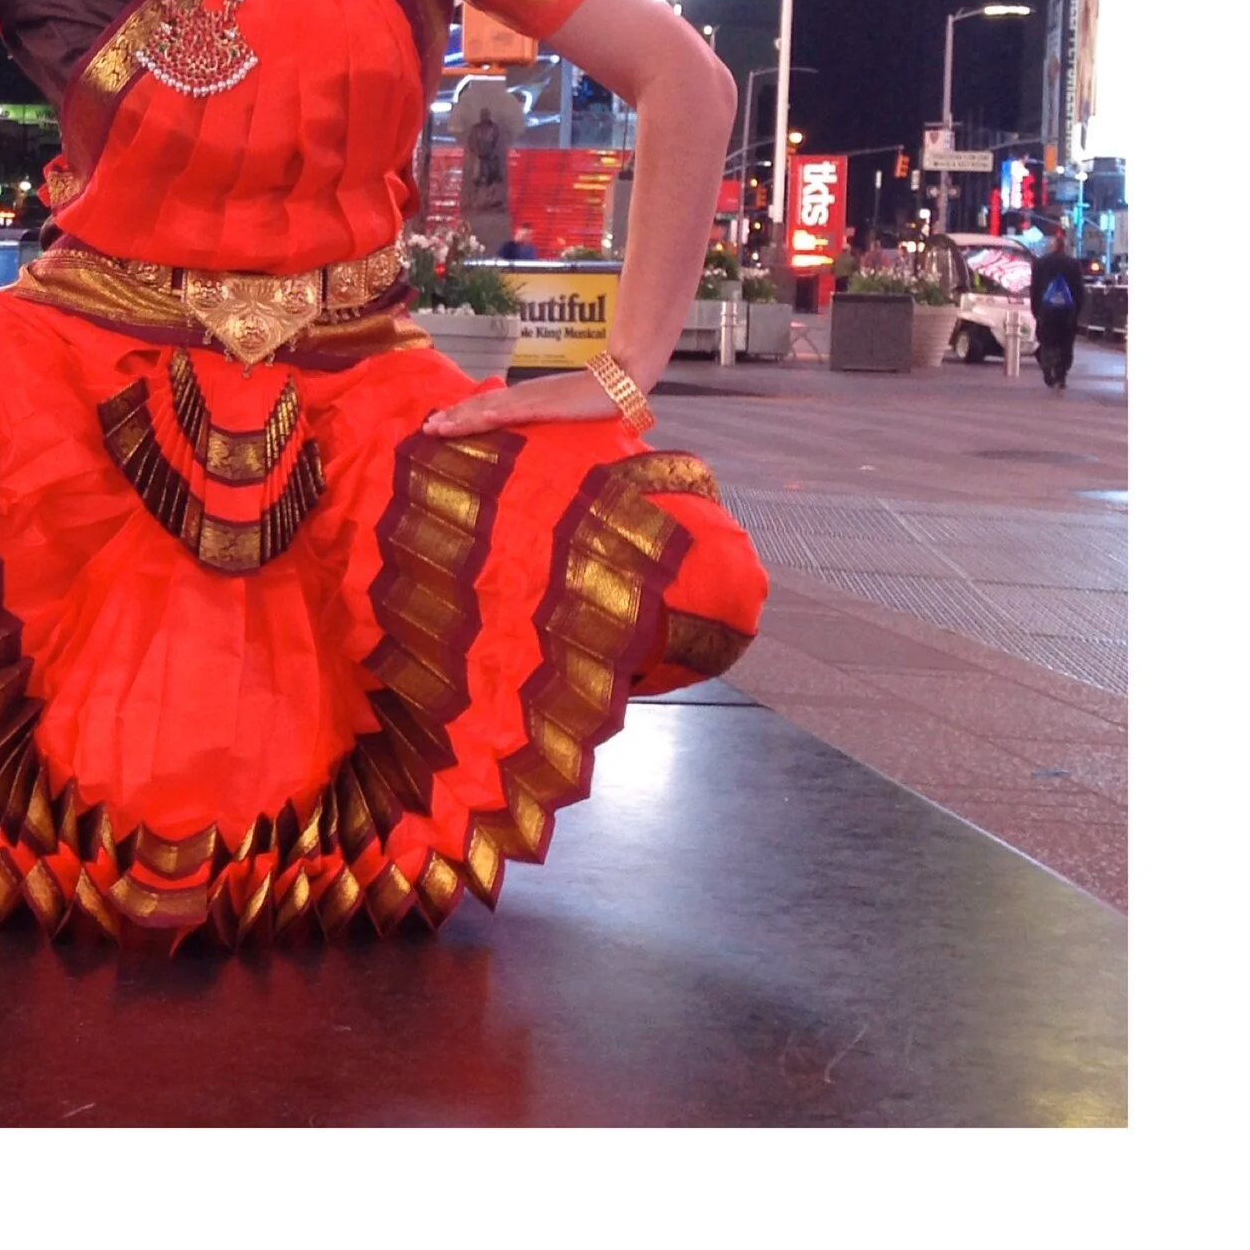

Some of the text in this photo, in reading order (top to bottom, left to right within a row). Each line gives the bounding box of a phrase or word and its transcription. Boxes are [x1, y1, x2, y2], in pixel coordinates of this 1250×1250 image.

[801, 161, 838, 226] tkts
[536, 326, 562, 342] King
[564, 326, 607, 339] Musical
